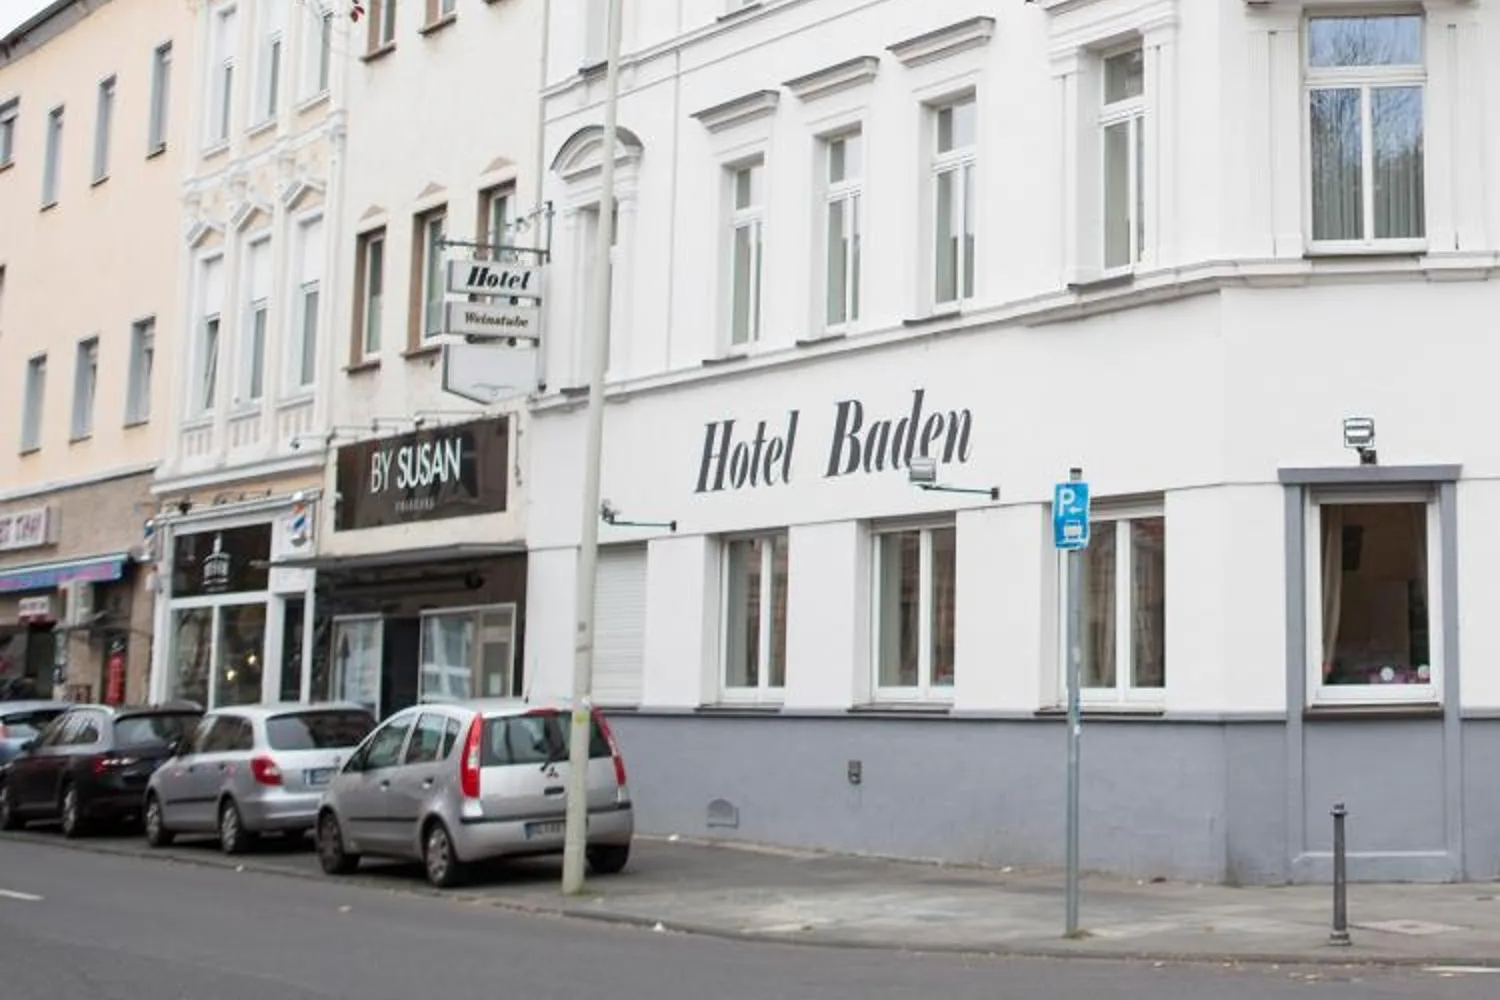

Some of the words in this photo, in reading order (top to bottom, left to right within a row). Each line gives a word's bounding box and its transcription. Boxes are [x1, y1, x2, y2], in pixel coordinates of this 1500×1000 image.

[466, 266, 530, 290] Hotel
[694, 409, 800, 493] Hotel
[822, 388, 973, 478] Baden
[371, 449, 393, 493] BY
[397, 437, 462, 489] SUSAN
[1059, 488, 1076, 516] P
